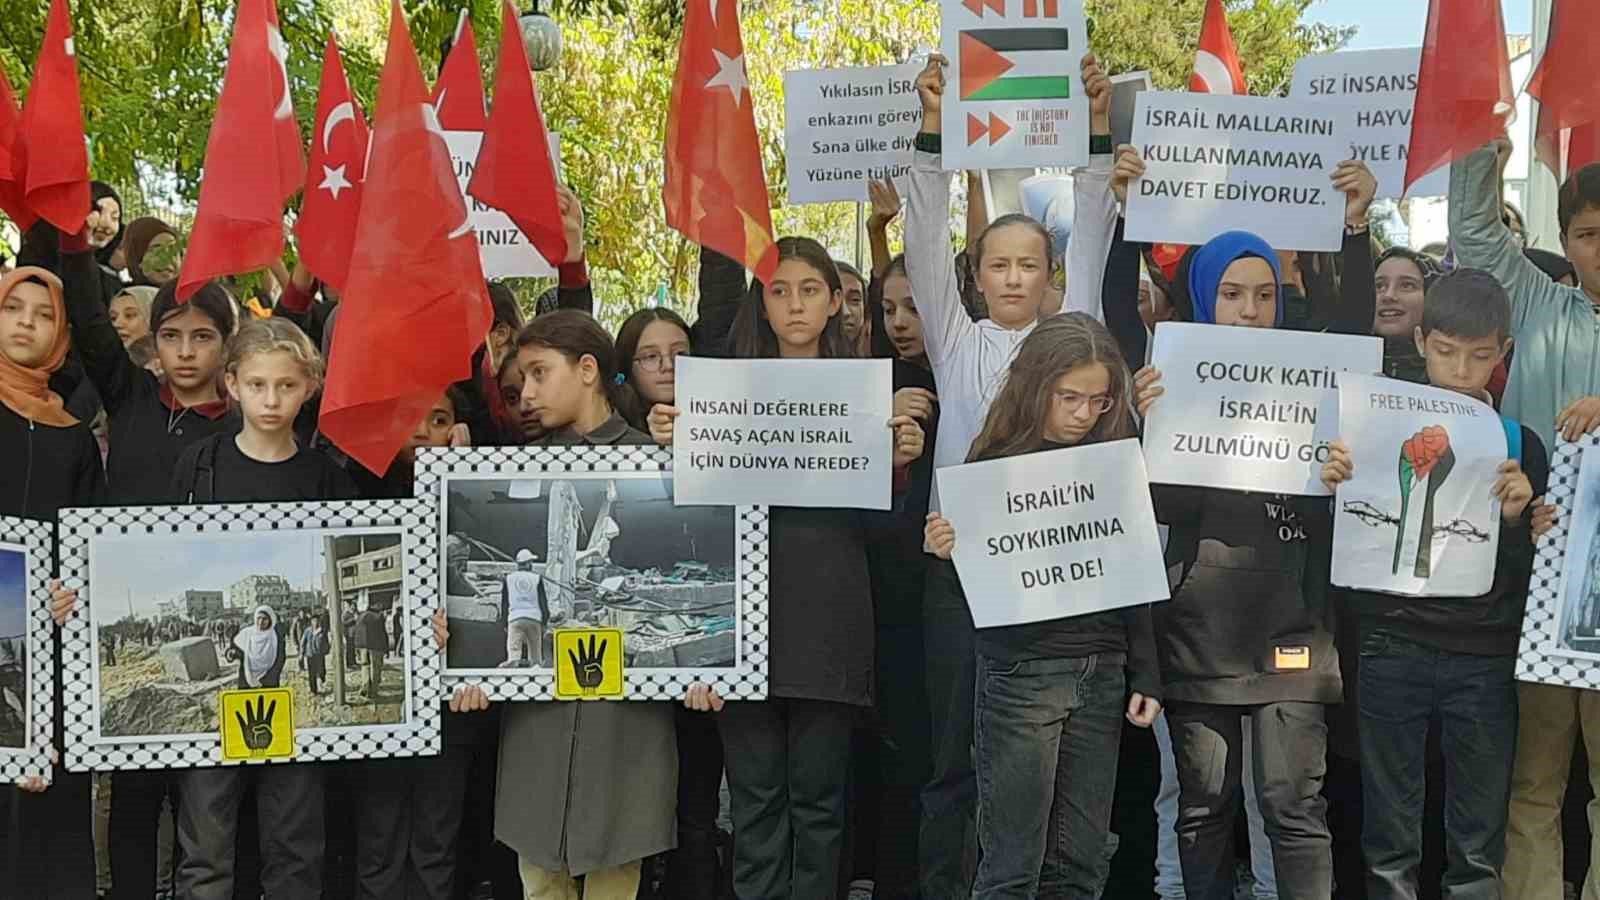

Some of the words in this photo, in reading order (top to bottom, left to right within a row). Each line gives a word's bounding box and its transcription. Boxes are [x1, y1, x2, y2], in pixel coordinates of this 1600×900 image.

[1309, 75, 1336, 95] SİZ
[1343, 73, 1417, 93] İNSANS
[808, 112, 873, 127] enkazını
[1145, 105, 1209, 129] İSRAİL
[1216, 112, 1334, 136] MALLARINI
[812, 141, 850, 154] Sana
[856, 138, 887, 152] ülke
[1143, 144, 1323, 169] KULLANMAMAYA
[806, 167, 863, 182] Yüzüne
[1140, 179, 1208, 199] DAVET
[1214, 180, 1326, 205] EDİYORUZ.
[473, 227, 520, 245] INIZ
[1196, 361, 1274, 384] ÇOCUK
[1281, 366, 1347, 389] KATİL
[690, 397, 747, 416] İNSANİ
[753, 397, 848, 417] DEĞERLERE
[1219, 395, 1318, 425] İSRAİL'İN
[1369, 393, 1405, 410] FREE
[1408, 395, 1480, 417] PALESTINE
[690, 427, 742, 446] SAVAŞ
[747, 428, 794, 446] AÇAN
[800, 426, 853, 444] İSRAİL
[1174, 433, 1290, 461] ZULMÜNÜ
[690, 451, 724, 471] İÇİN
[729, 453, 789, 470] DÜNYA
[794, 456, 870, 471] NEREDE?
[1006, 481, 1095, 515] İSRAİL'İN
[987, 517, 1125, 556] SOYKIRIMINA
[1021, 565, 1065, 589] DUR
[1070, 557, 1104, 581] DE!
